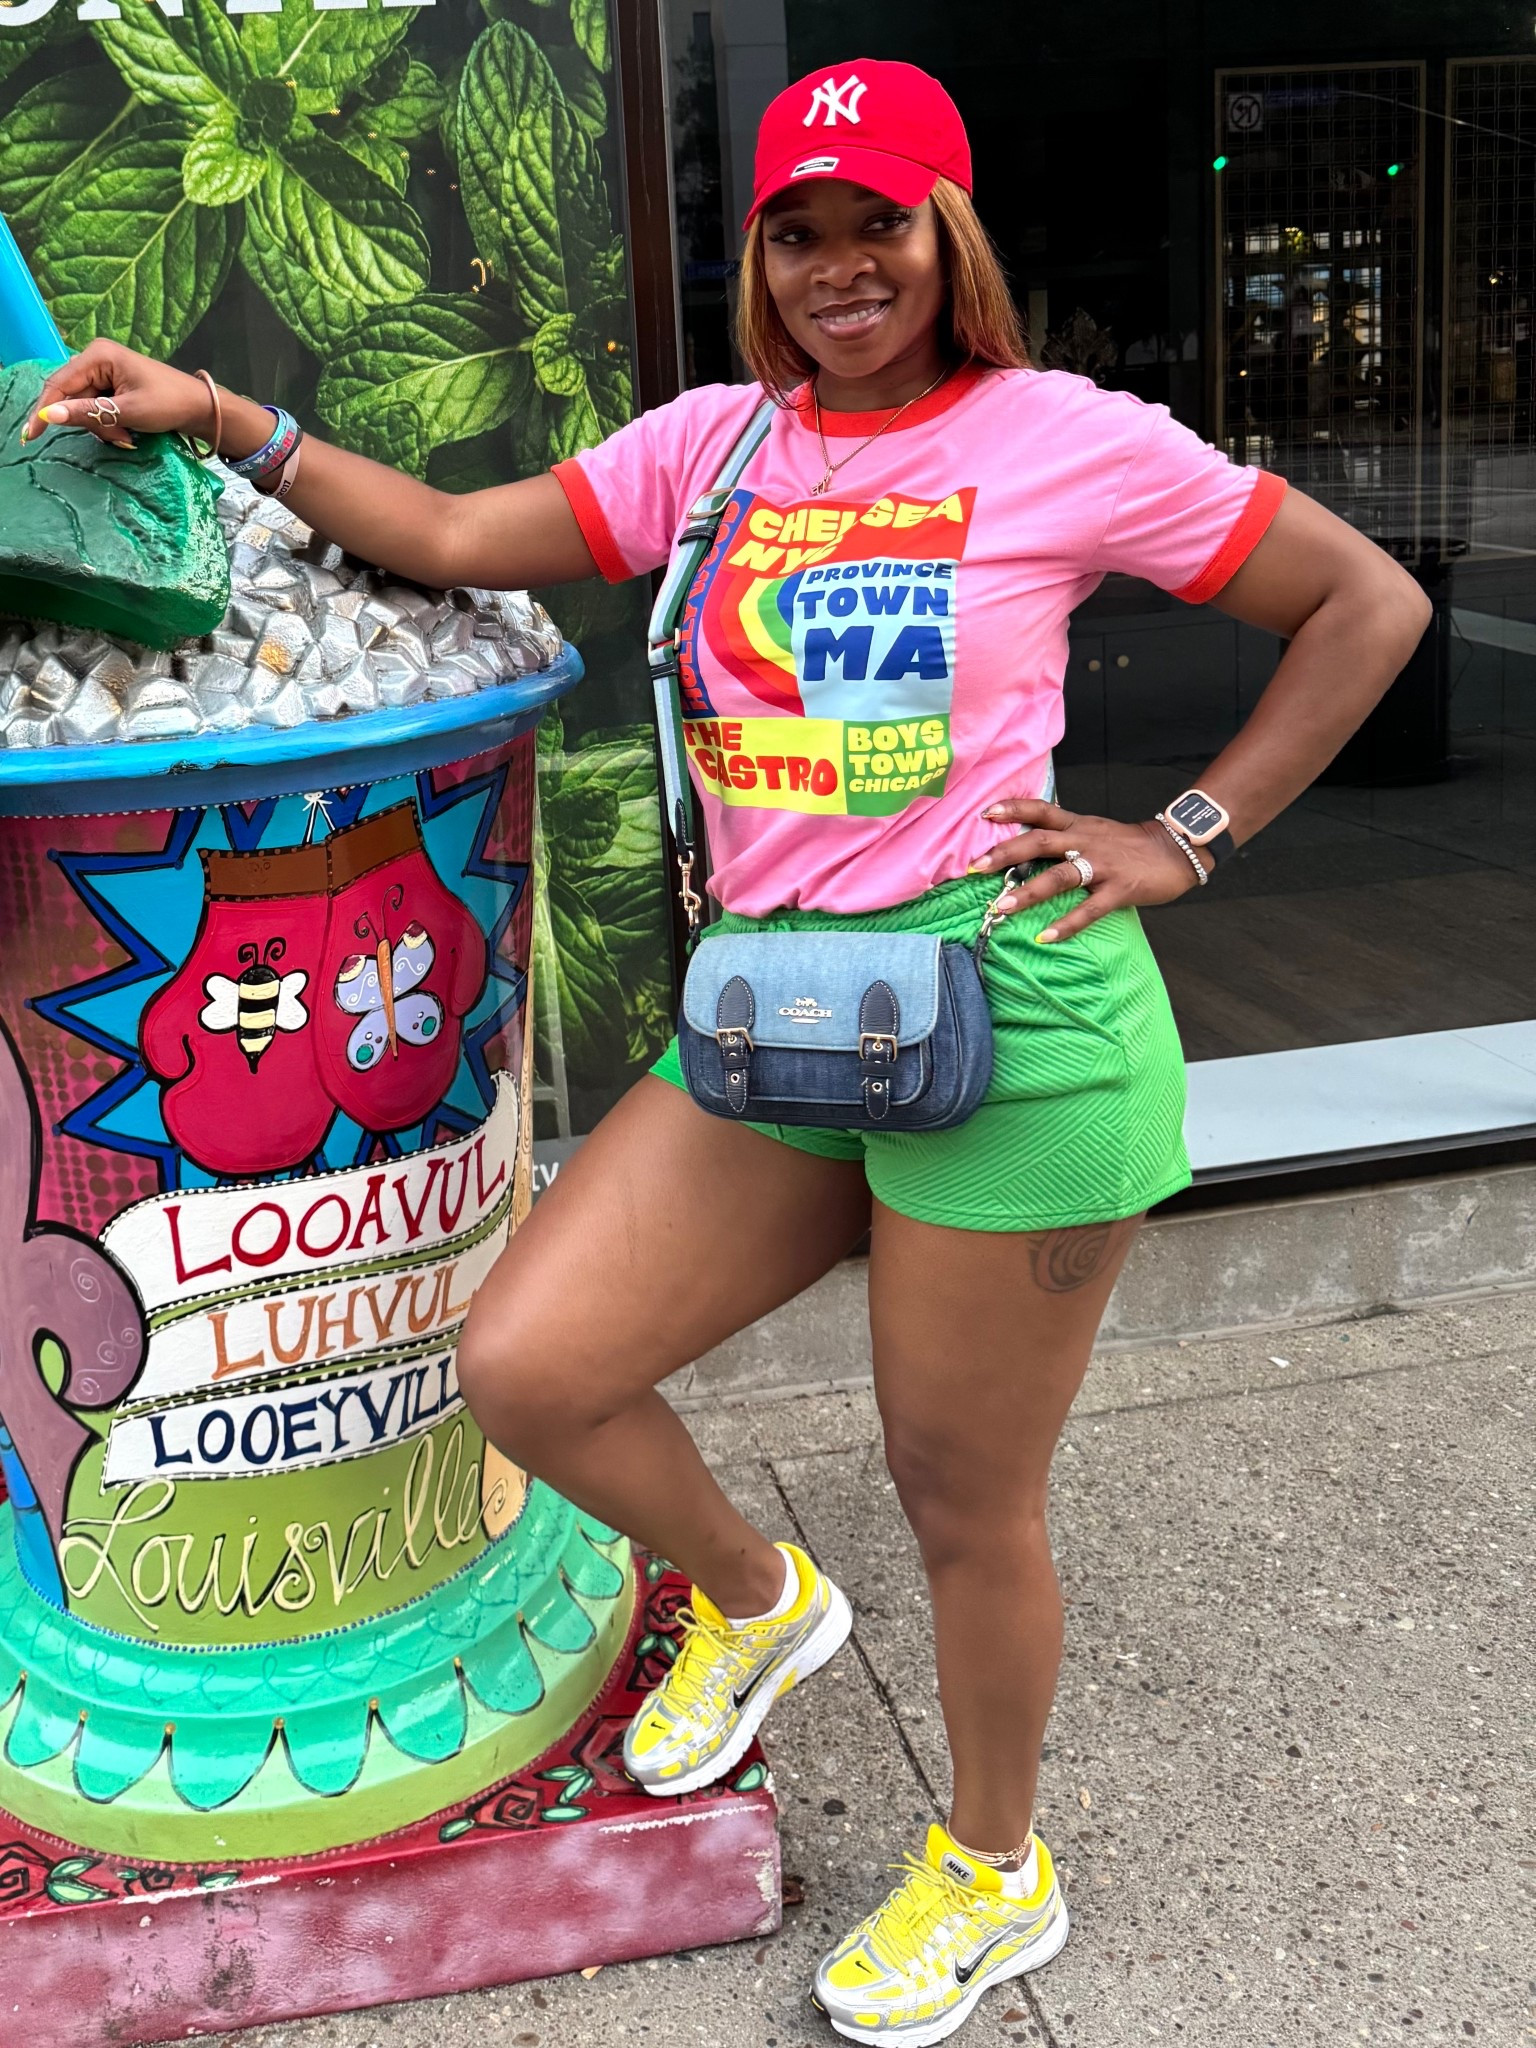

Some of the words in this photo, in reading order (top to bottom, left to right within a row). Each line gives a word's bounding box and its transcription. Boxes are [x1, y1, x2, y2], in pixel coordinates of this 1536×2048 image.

[802, 74, 868, 128] NY
[276, 479, 292, 498] 2017
[749, 493, 964, 543] CHELSEA
[806, 562, 953, 585] PROVINCE
[797, 586, 949, 620] TOWN
[803, 625, 949, 681] MA
[683, 721, 743, 751] THE
[847, 719, 945, 752] BOYS
[694, 748, 838, 797] CASTRO
[848, 746, 949, 775] TOWN
[849, 767, 947, 793] CHICAGO
[778, 1007, 833, 1018] COACH
[163, 1133, 506, 1285] LOOAVUL
[207, 1261, 477, 1381] LUHVUL
[148, 1356, 463, 1468] LOOEYVILL
[58, 1420, 507, 1632] Louisville
[946, 1860, 970, 1881] NIKE
